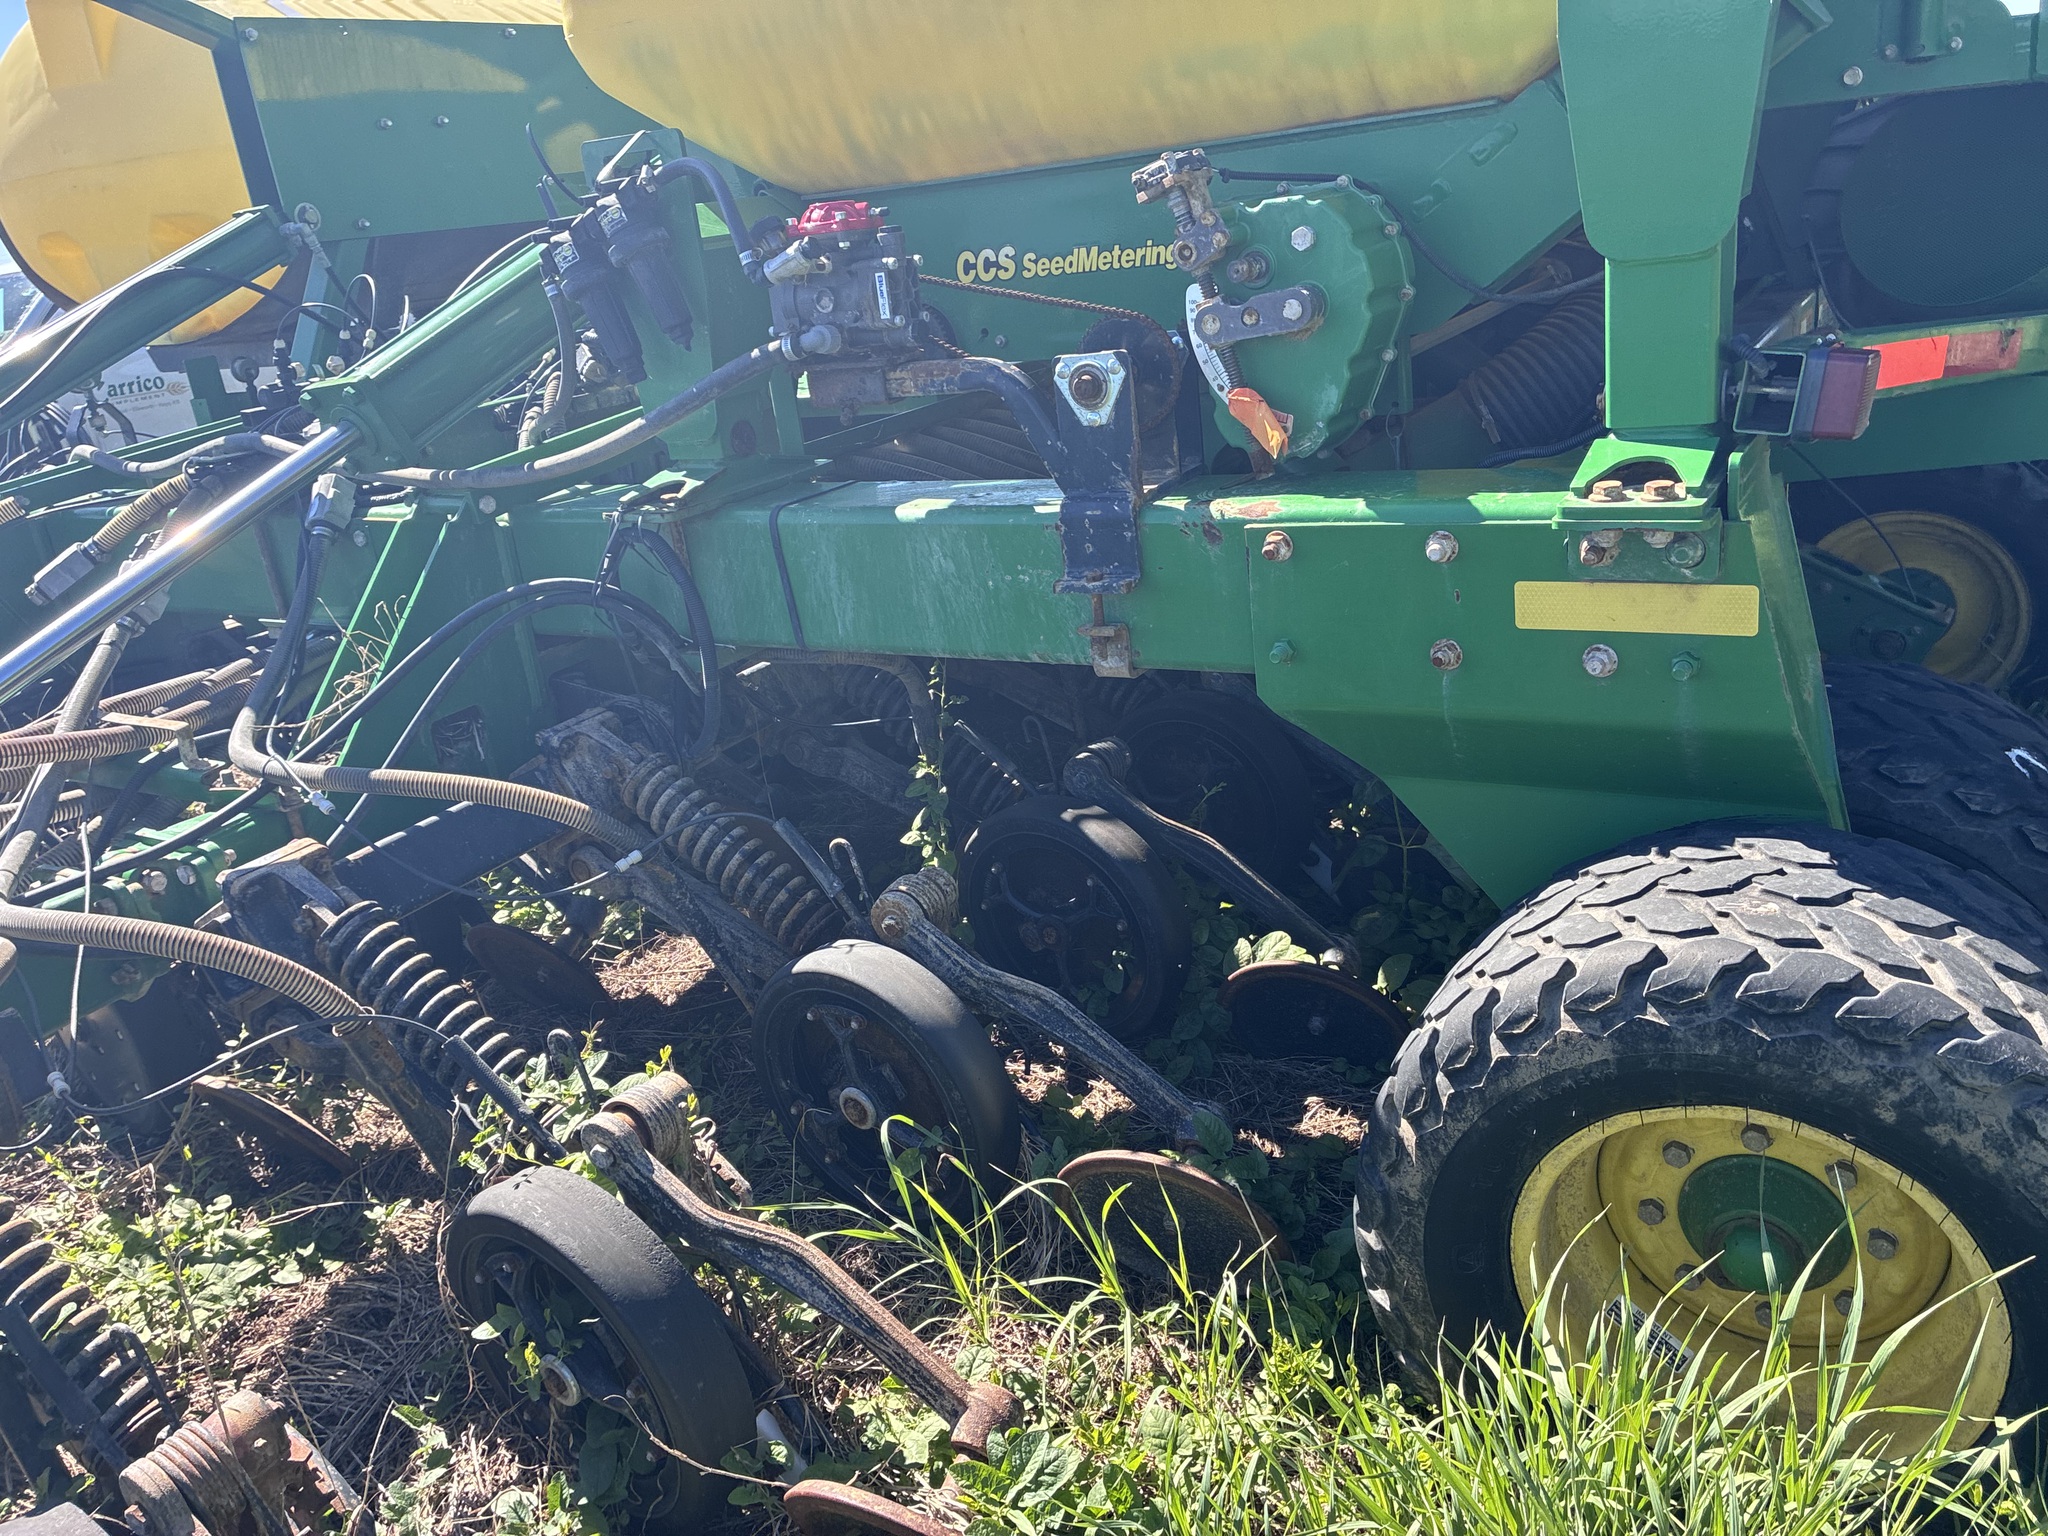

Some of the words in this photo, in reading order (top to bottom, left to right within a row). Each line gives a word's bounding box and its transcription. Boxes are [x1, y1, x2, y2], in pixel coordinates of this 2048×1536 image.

[956, 245, 1017, 284] CCS
[1022, 239, 1178, 279] SeedMetering
[877, 274, 888, 317] BlueFlex
[101, 376, 165, 400] arrico
[113, 392, 165, 405] MPLEMENT
[1635, 1309, 1672, 1340] IMRTNT
